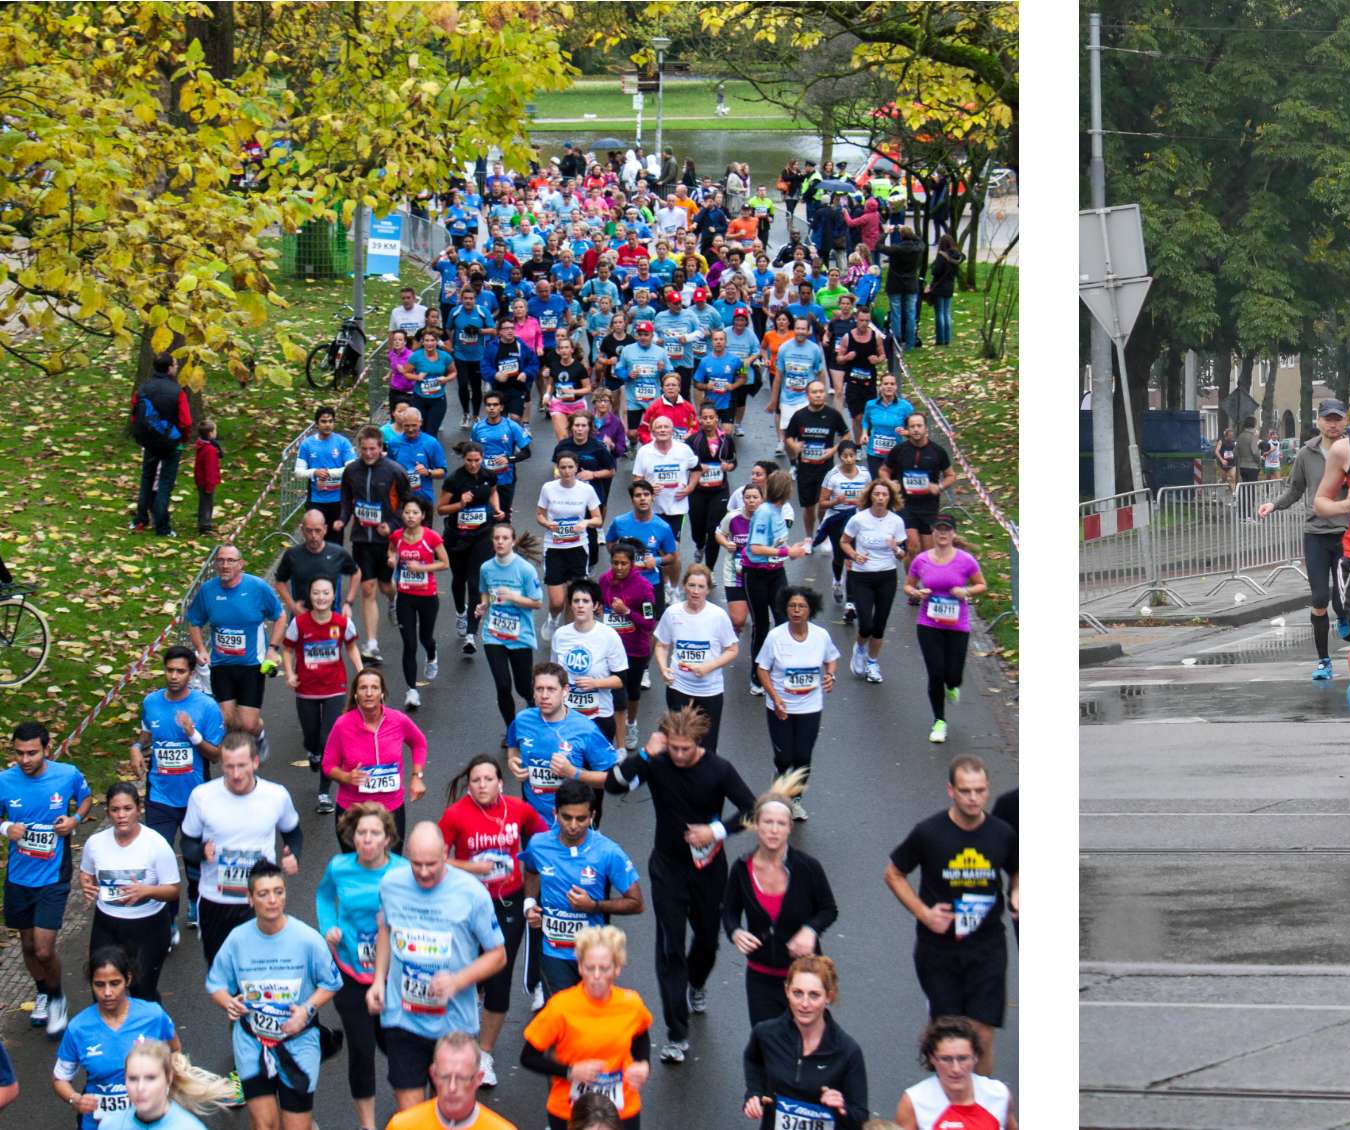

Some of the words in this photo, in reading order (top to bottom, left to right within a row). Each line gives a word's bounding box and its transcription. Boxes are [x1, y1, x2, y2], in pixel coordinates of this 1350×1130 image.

[568, 652, 588, 668] DAS
[680, 650, 706, 660] 41567
[568, 693, 594, 704] 42715
[158, 749, 188, 761] 44323
[365, 776, 396, 789] 42765
[22, 831, 55, 845] 44182
[782, 1114, 826, 1130] 37418
